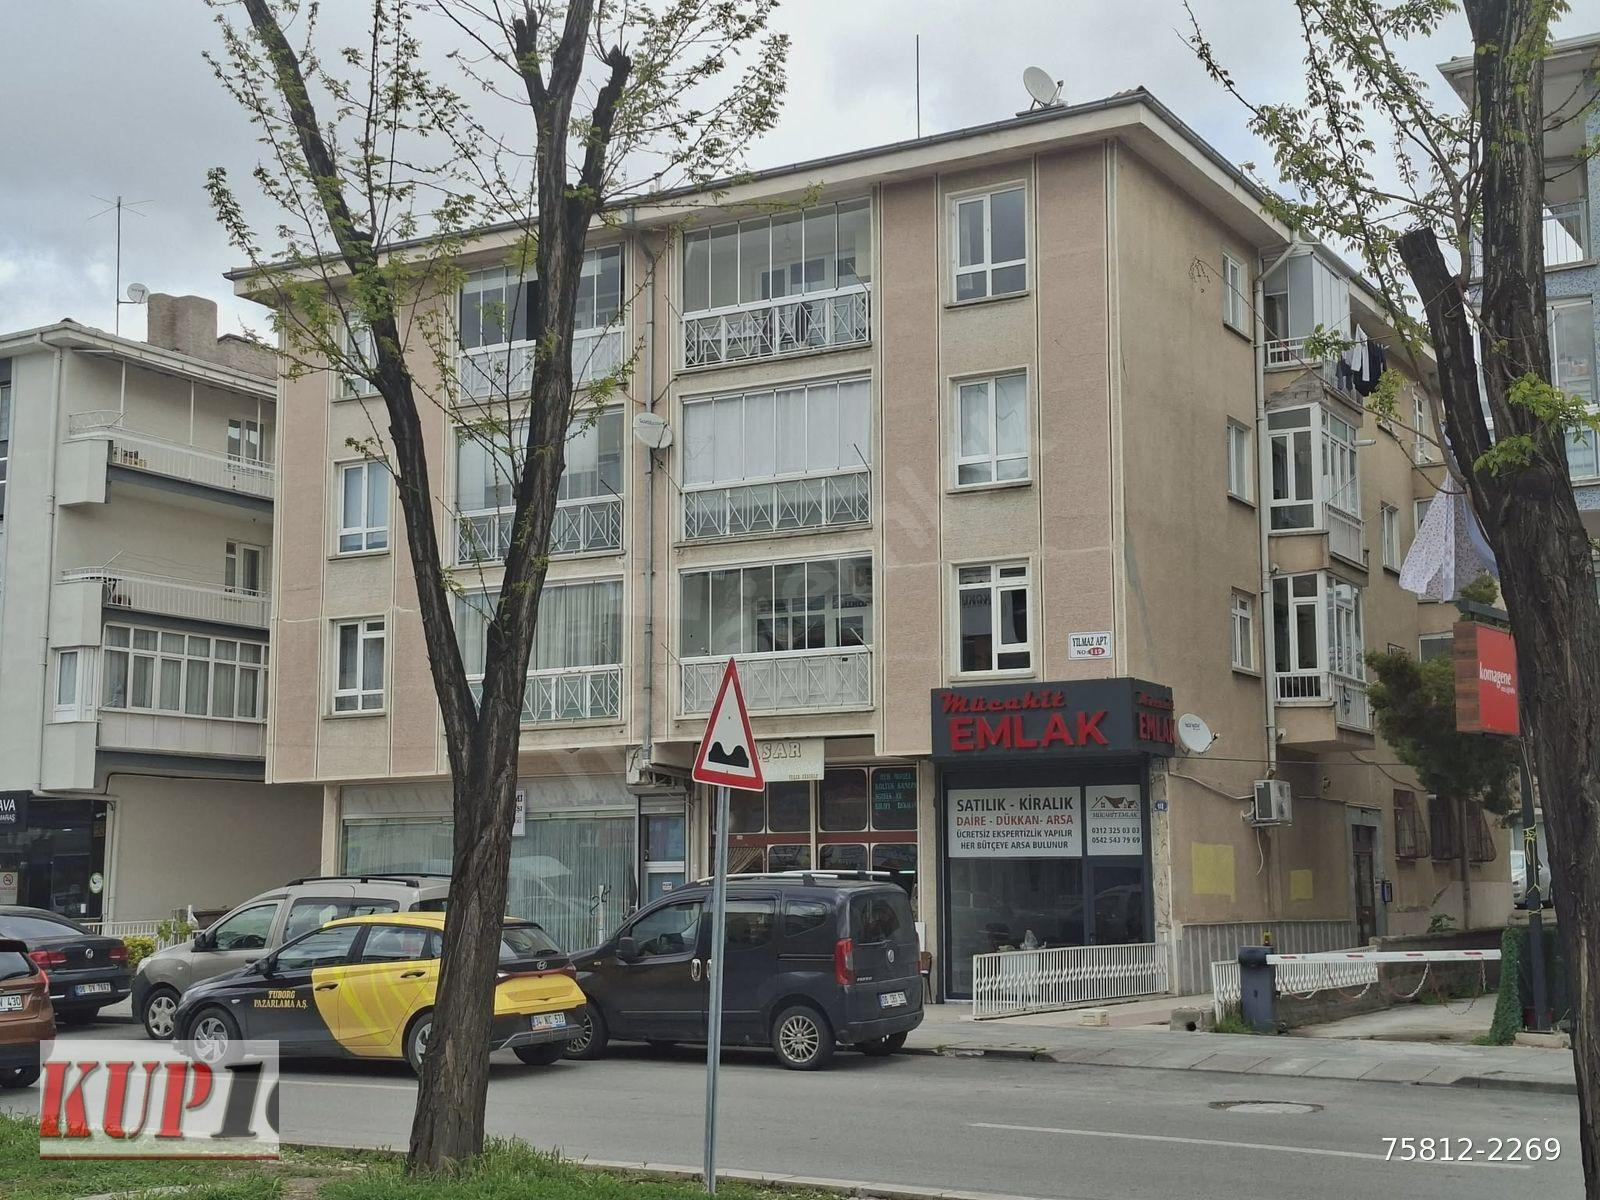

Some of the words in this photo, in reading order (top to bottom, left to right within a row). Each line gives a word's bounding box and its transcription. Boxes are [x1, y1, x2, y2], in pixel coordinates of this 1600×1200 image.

[1480, 661, 1511, 688] komagene
[950, 711, 1110, 751] EMLAK
[758, 742, 801, 762] ŞAR
[957, 798, 1006, 812] SATILIK
[1019, 794, 1073, 811] KİRALIK
[956, 813, 986, 826] DAİRE
[1046, 814, 1073, 825] ARSA
[956, 828, 990, 838] ÜCRETSİZ
[1044, 829, 1073, 838] YAPILIR
[960, 841, 975, 850] HER
[976, 840, 1008, 851] BÜTÇEYE
[1010, 841, 1031, 849] ARSA
[1033, 841, 1068, 849] BULUNUR
[1091, 836, 1107, 844] 0542
[269, 990, 296, 999] TUBORG
[253, 999, 295, 1008] PAZARLAMA
